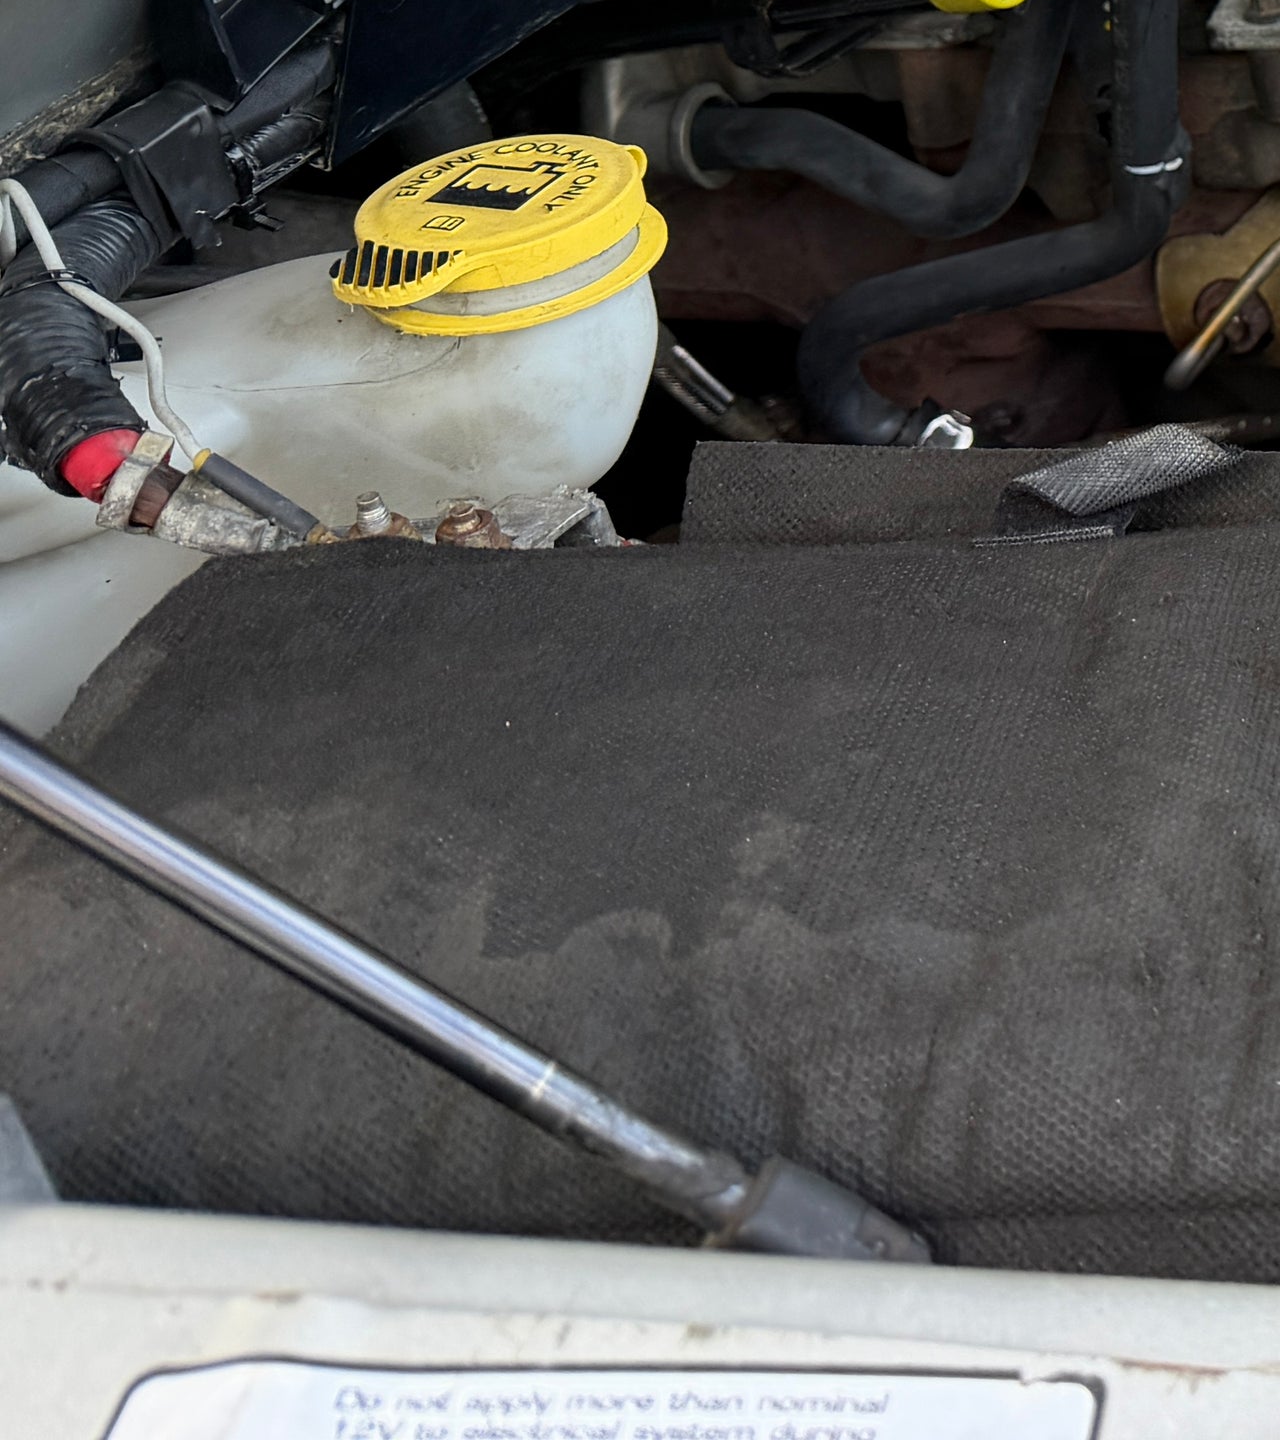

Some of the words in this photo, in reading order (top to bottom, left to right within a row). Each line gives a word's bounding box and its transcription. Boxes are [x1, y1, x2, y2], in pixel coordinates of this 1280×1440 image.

[394, 150, 484, 200] ENGINE
[494, 142, 600, 173] COOLANT
[544, 173, 598, 213] ONLY
